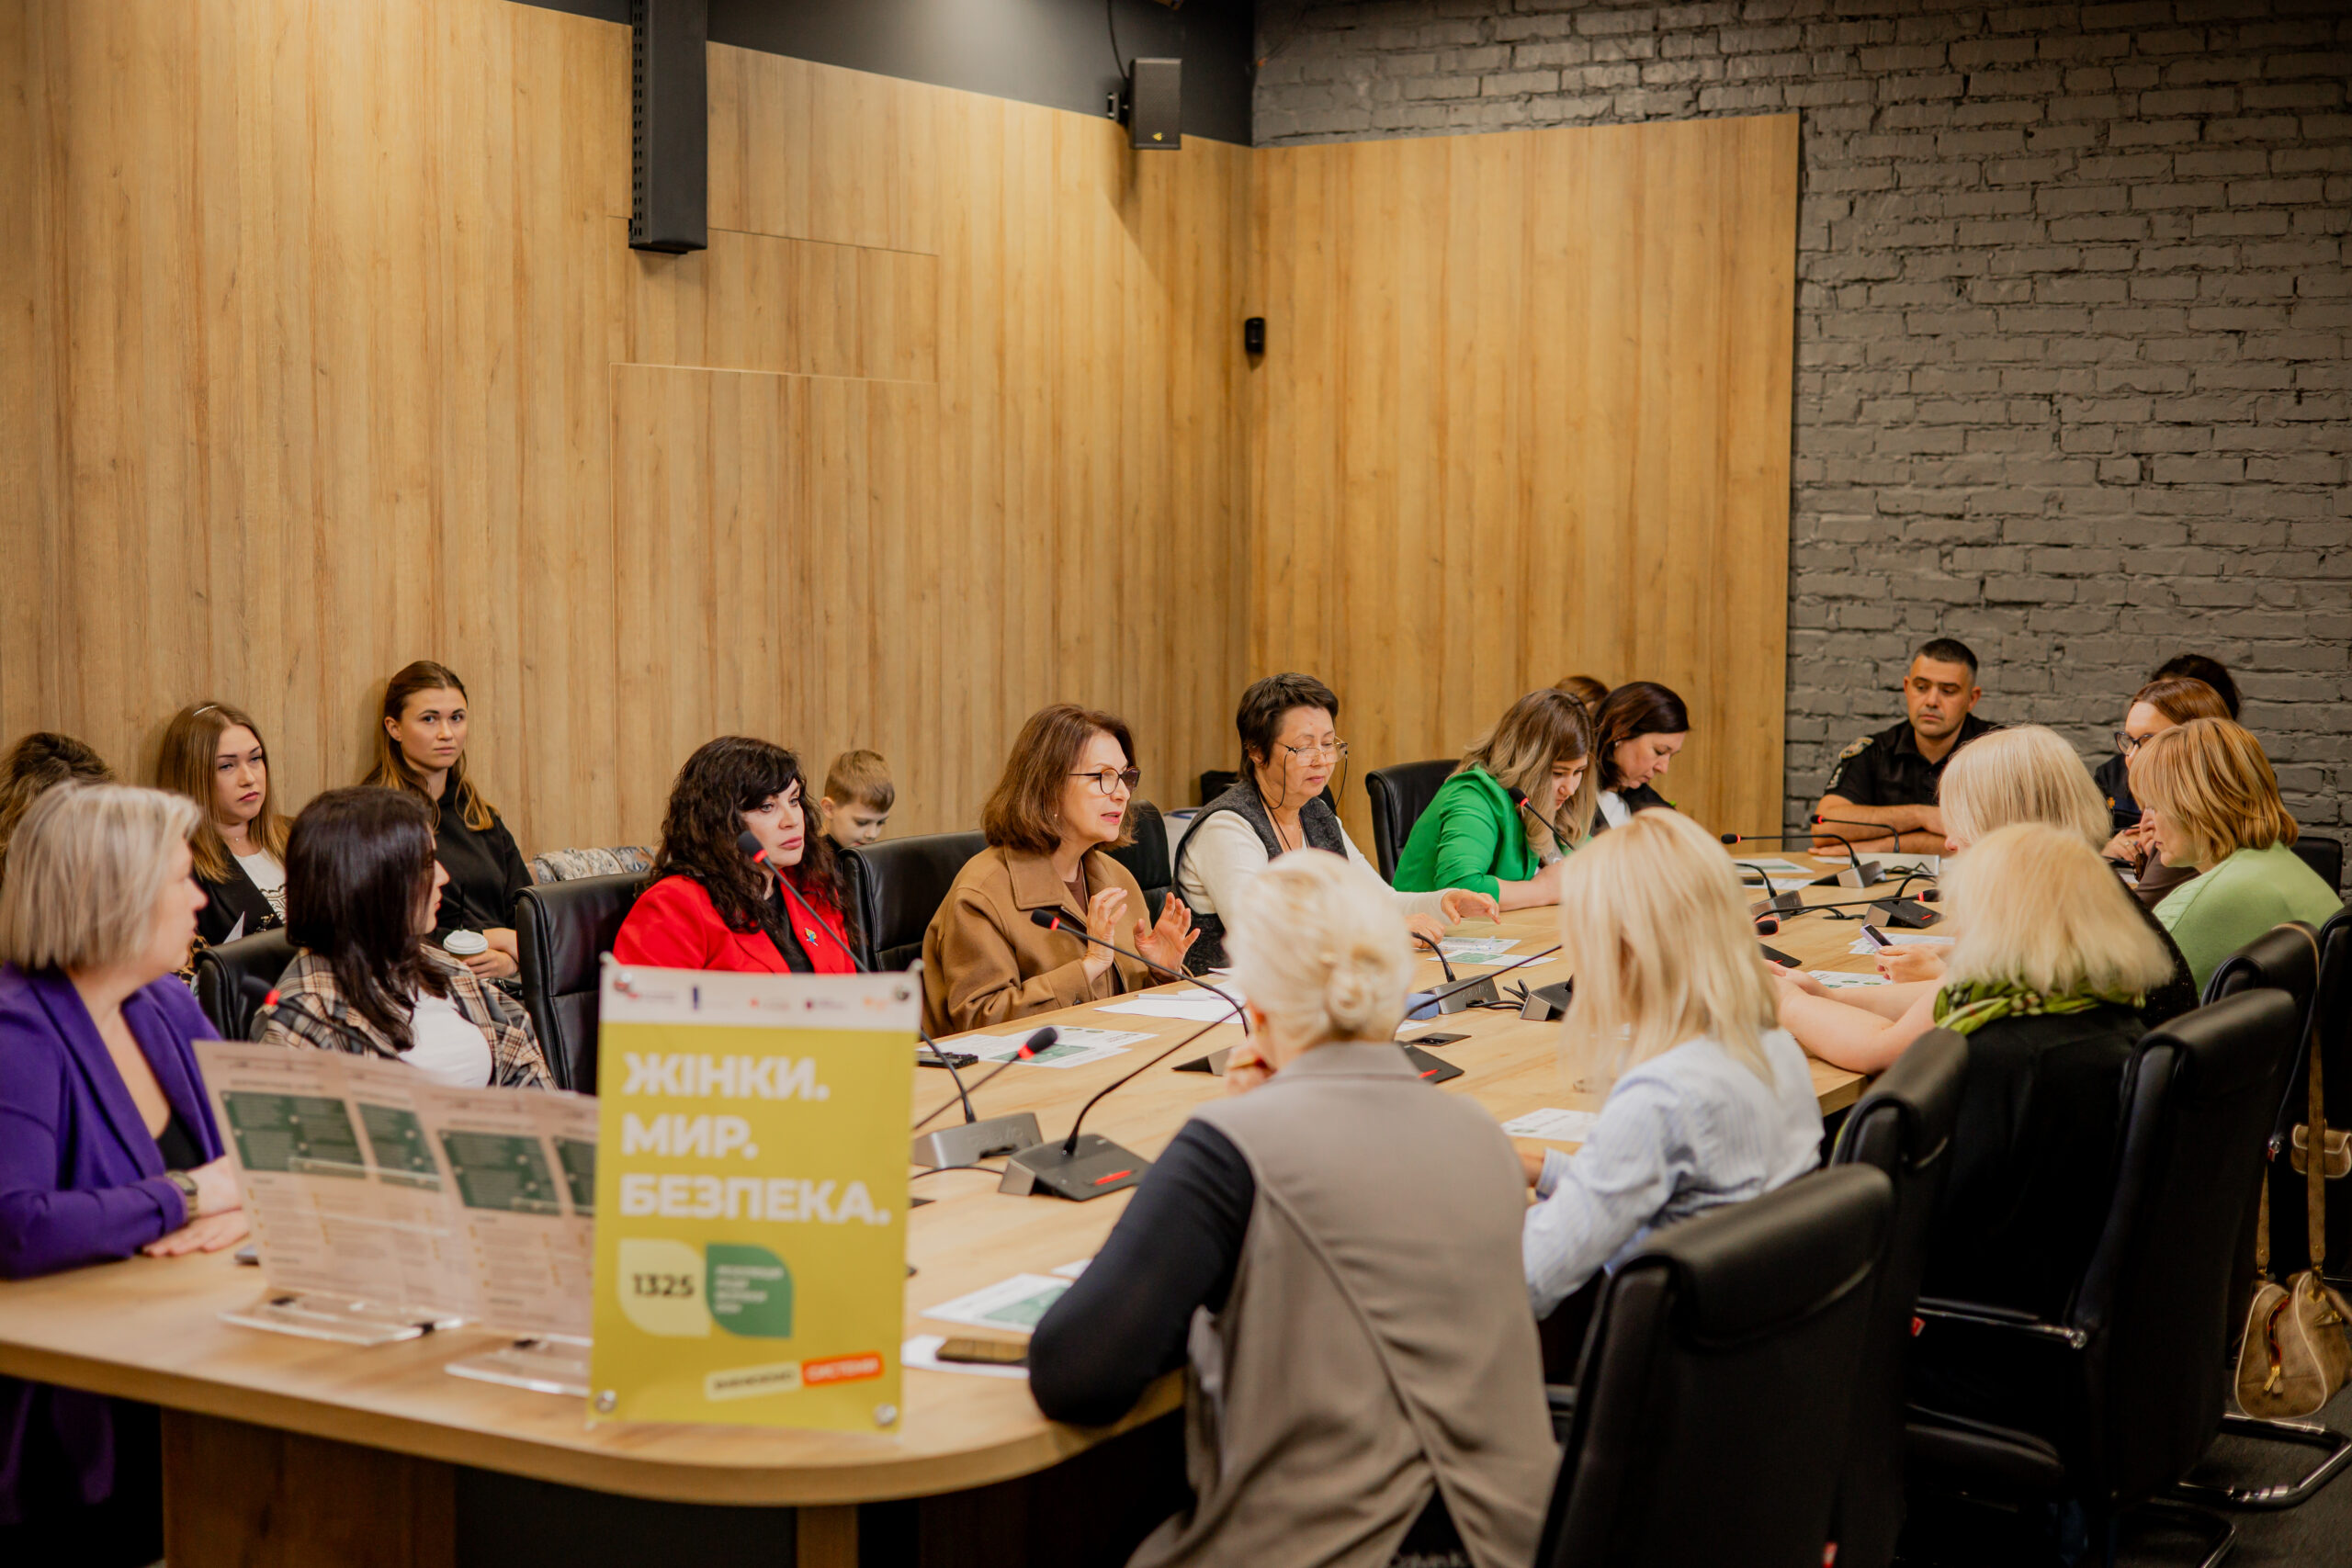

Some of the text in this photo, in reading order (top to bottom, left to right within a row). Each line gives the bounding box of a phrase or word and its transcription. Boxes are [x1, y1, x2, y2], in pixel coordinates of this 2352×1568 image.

[622, 1052, 830, 1100] ЖІНКИ.
[621, 1112, 760, 1160] МИР.
[619, 1173, 891, 1226] БЕЗПЕКА.
[633, 1274, 695, 1298] 1325
